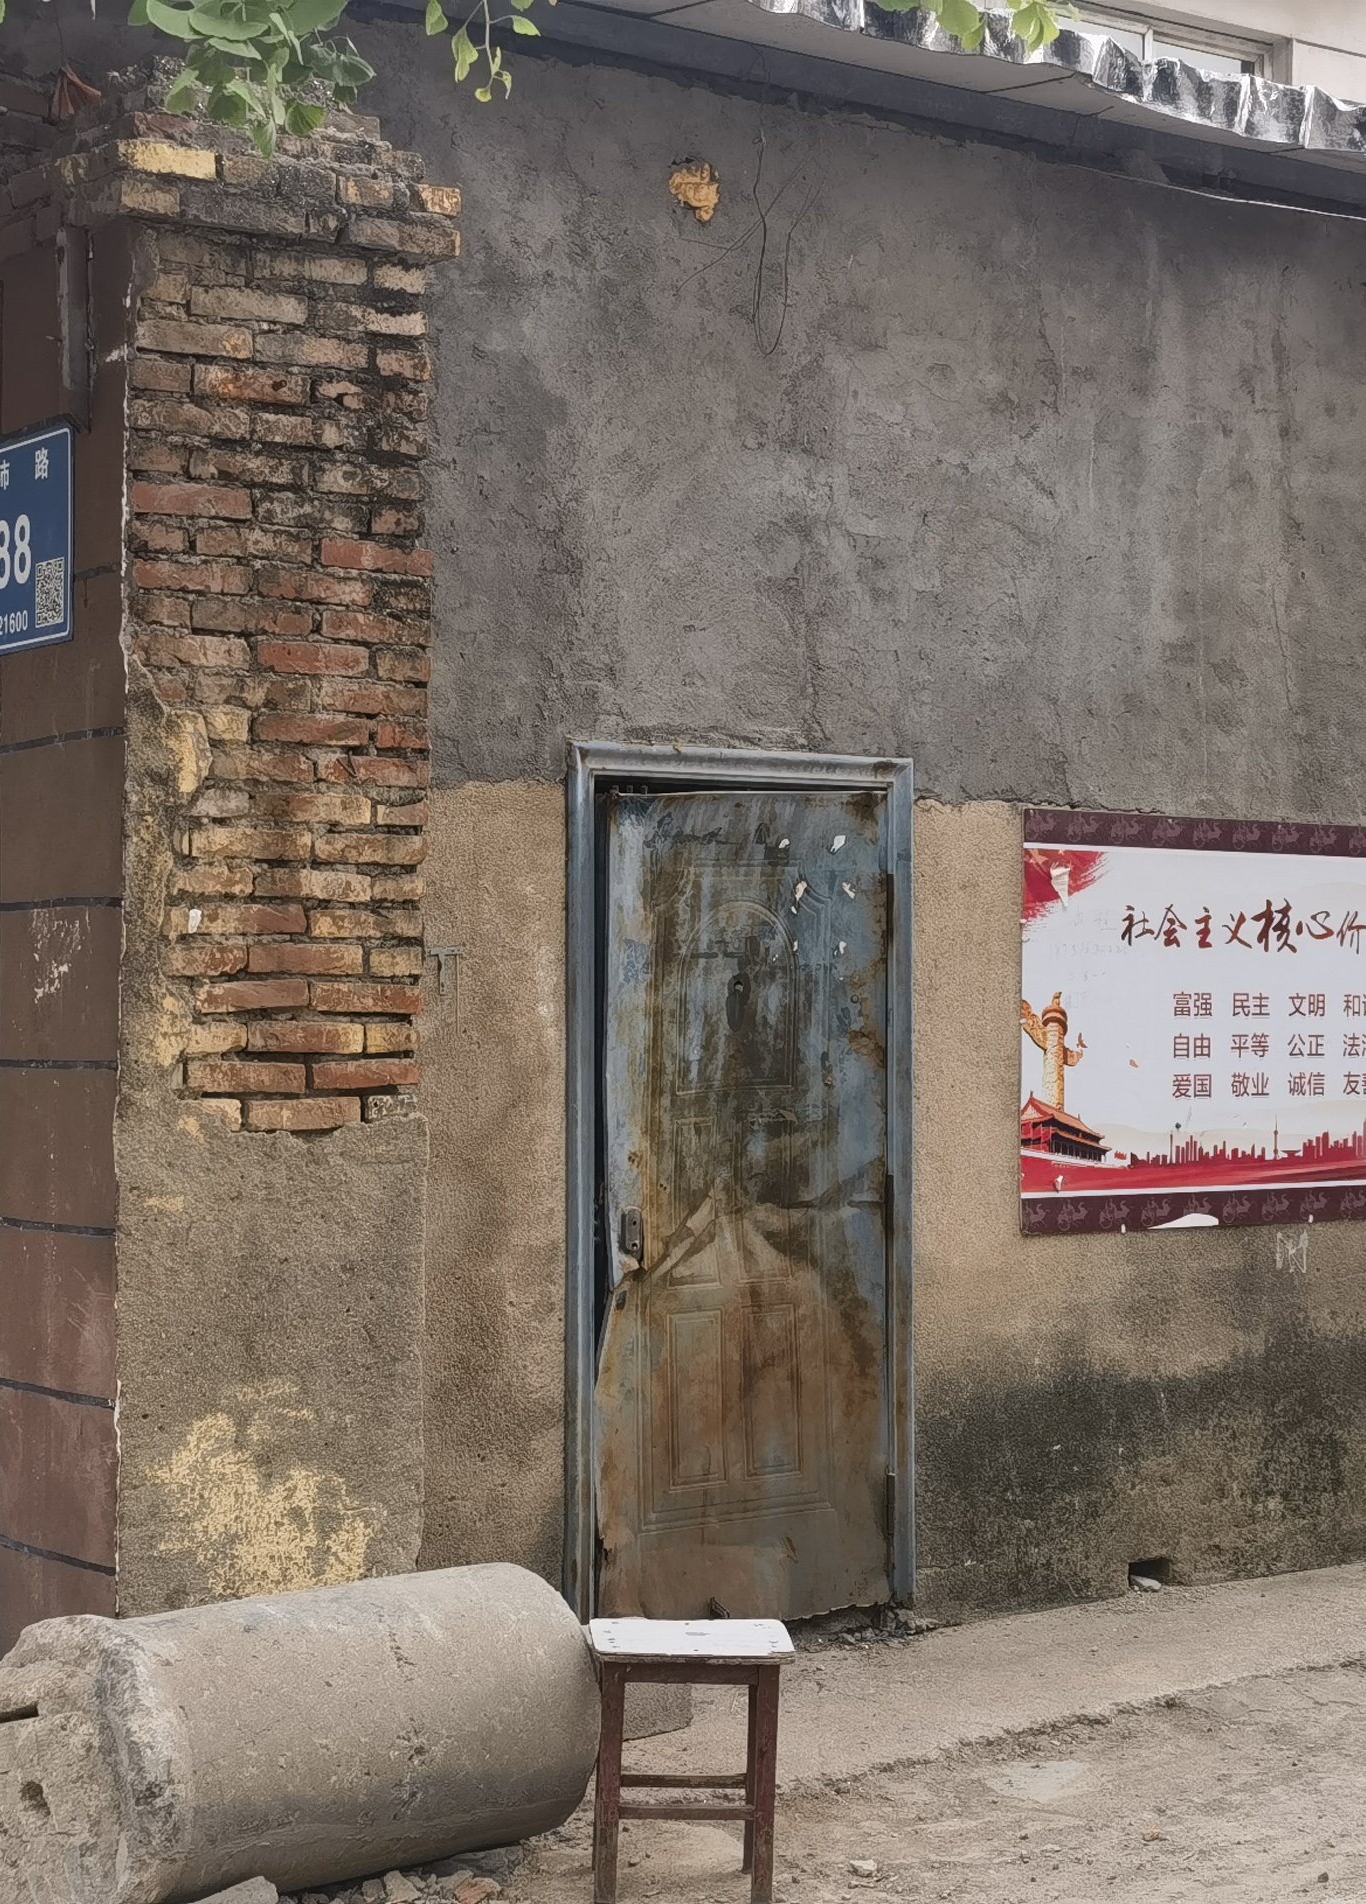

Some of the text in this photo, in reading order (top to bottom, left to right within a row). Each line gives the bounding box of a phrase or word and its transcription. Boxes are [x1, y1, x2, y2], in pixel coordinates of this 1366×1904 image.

[1172, 991, 1213, 1018] 富强
[1232, 992, 1270, 1018] 民主
[1288, 992, 1326, 1018] 文明
[1173, 1033, 1211, 1059] 自由
[1230, 1032, 1270, 1059] 平等
[1287, 1033, 1325, 1058] 公正
[1172, 1073, 1213, 1099] 爱国
[1231, 1071, 1270, 1098] 敬业
[1287, 1071, 1326, 1097] 诚信
